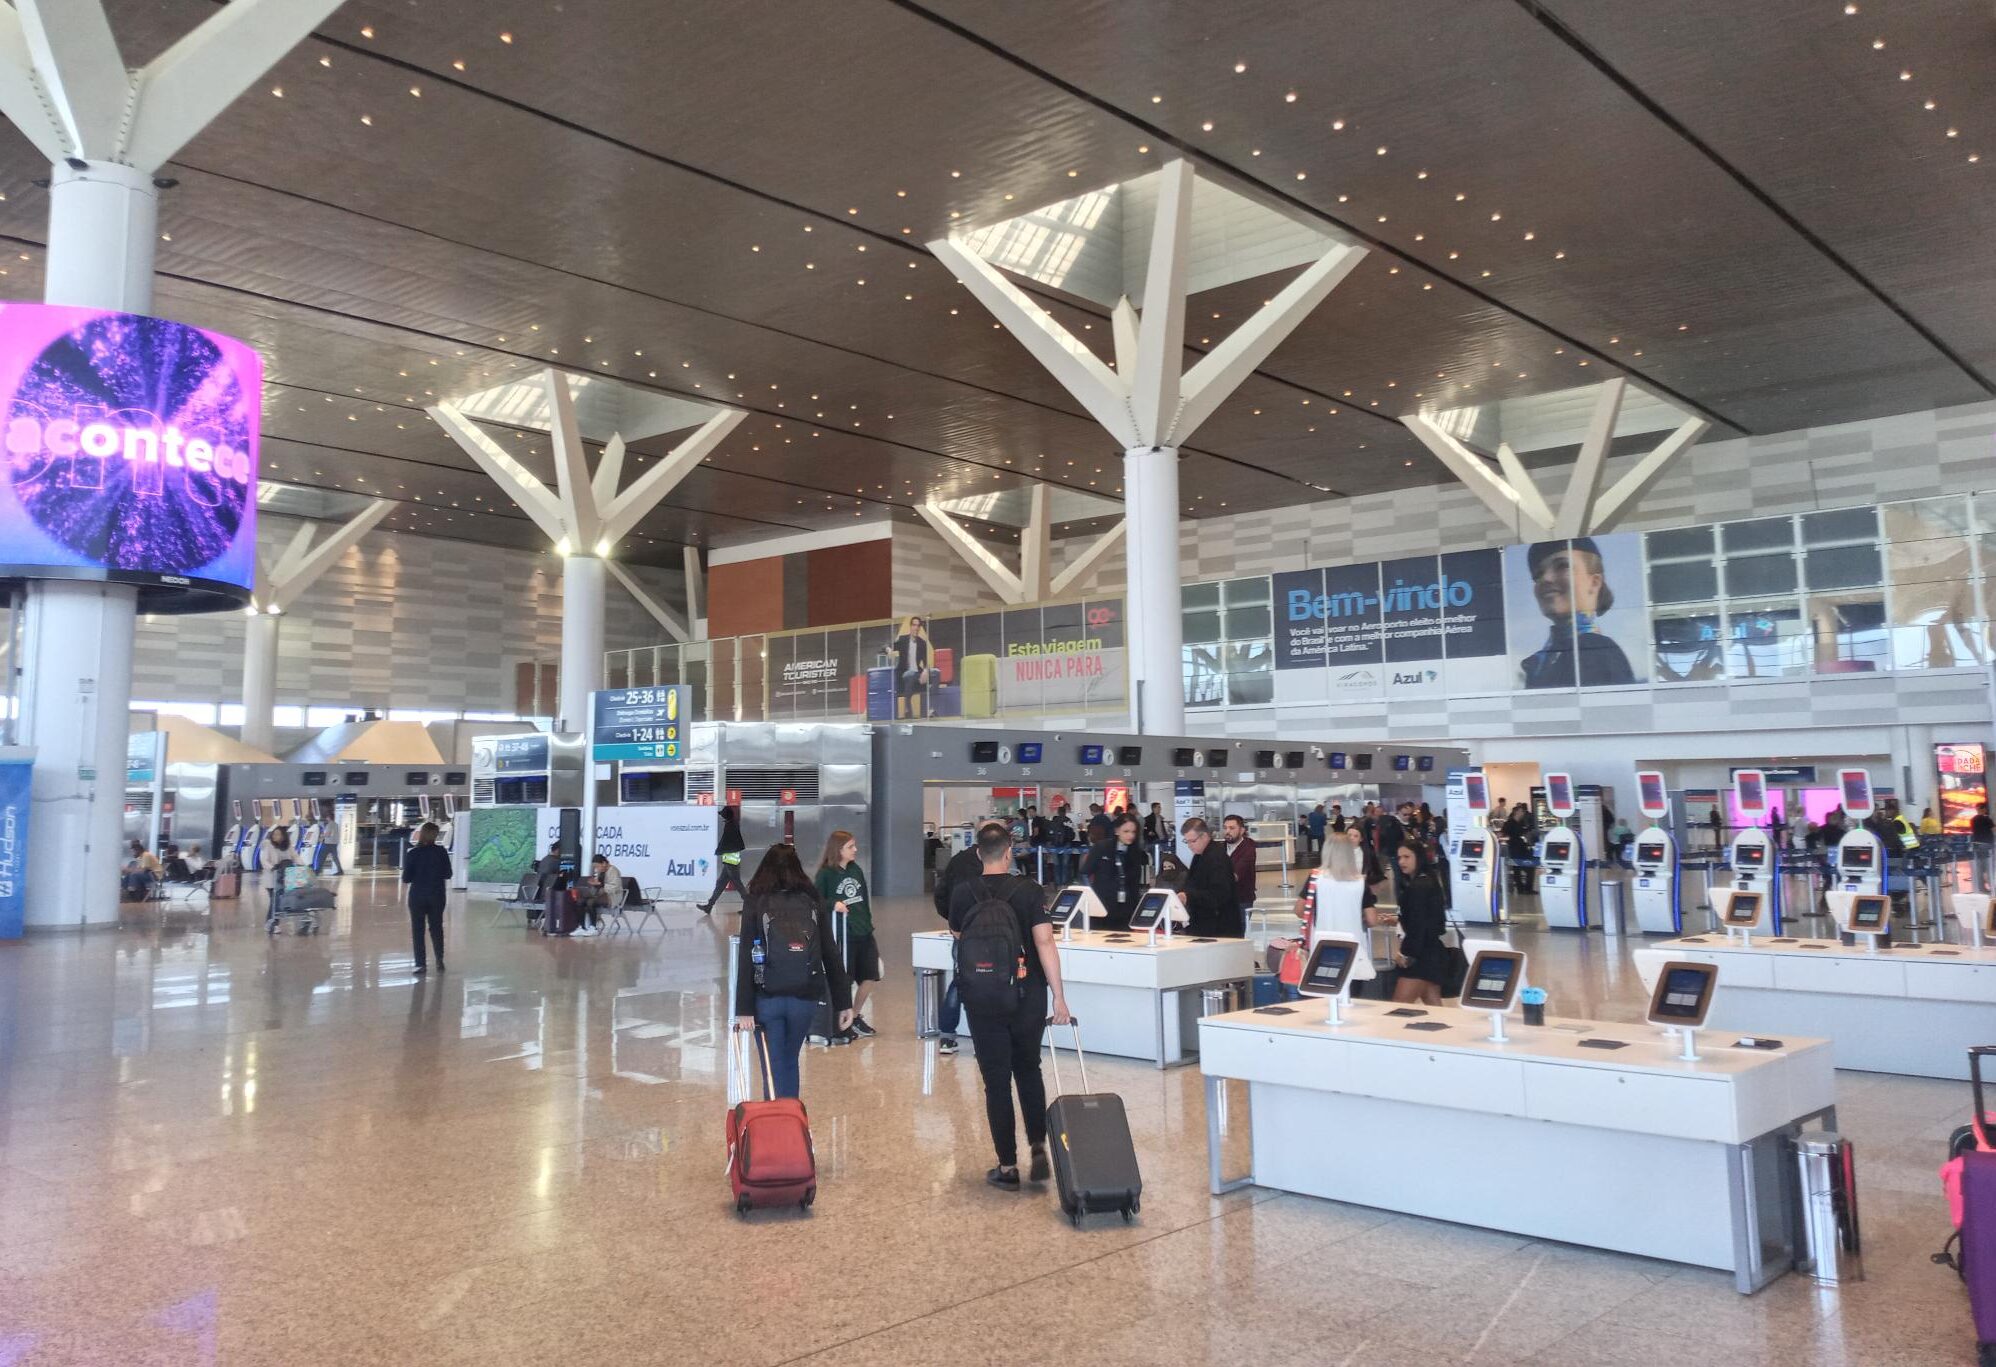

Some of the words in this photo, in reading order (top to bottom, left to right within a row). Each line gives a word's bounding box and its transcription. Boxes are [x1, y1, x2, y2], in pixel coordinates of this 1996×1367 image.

[1288, 575, 1472, 620] Bem-vindo
[1290, 627, 1311, 636] Você
[1334, 635, 1354, 643] com
[1008, 642, 1041, 657] Esta
[1042, 639, 1102, 657] viagem
[783, 659, 838, 671] AMERICAN
[1015, 658, 1062, 682] NUNCA
[1066, 655, 1103, 678] PARA
[783, 668, 837, 680] TOURISTER
[1393, 672, 1423, 685] Azul
[626, 690, 654, 704] 25-36
[632, 728, 653, 741] 1-24
[597, 826, 623, 839] CADA
[0, 806, 16, 877] Hudson
[598, 844, 612, 858] DO
[614, 844, 651, 857] BRASIL
[667, 859, 695, 876] Azul
